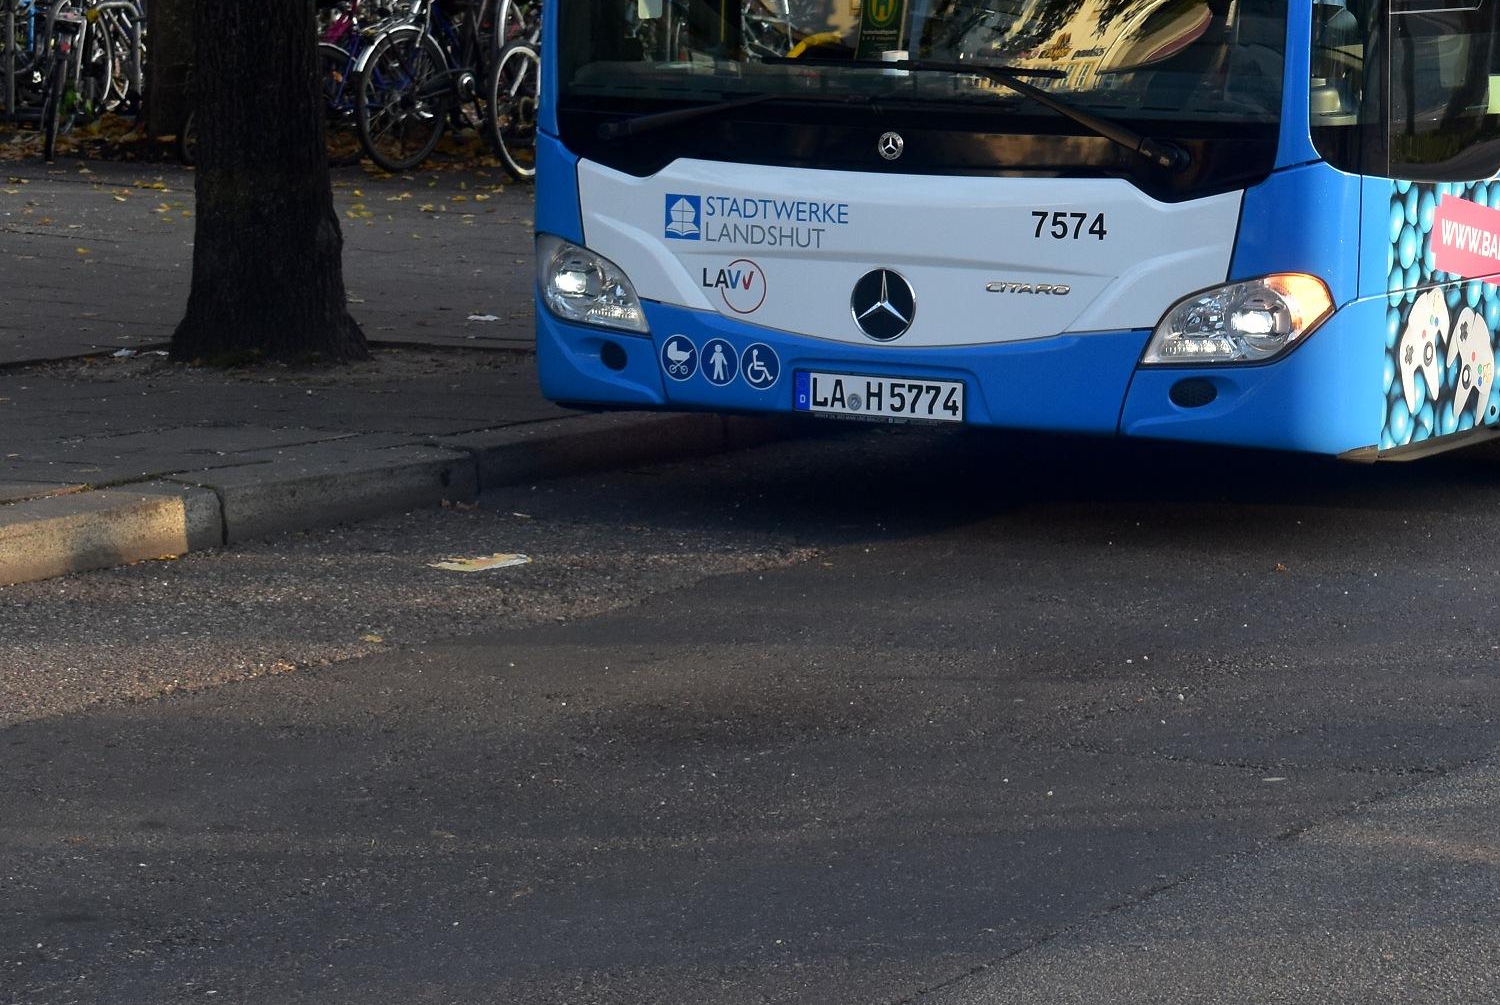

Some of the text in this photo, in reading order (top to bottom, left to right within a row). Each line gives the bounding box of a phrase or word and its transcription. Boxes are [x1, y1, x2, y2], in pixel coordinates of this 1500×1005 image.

[706, 196, 849, 225] STADTWERKE
[705, 221, 826, 249] LANDSHUT
[1031, 210, 1107, 241] 7574
[985, 281, 1071, 296] CITARO
[812, 377, 846, 409] LA
